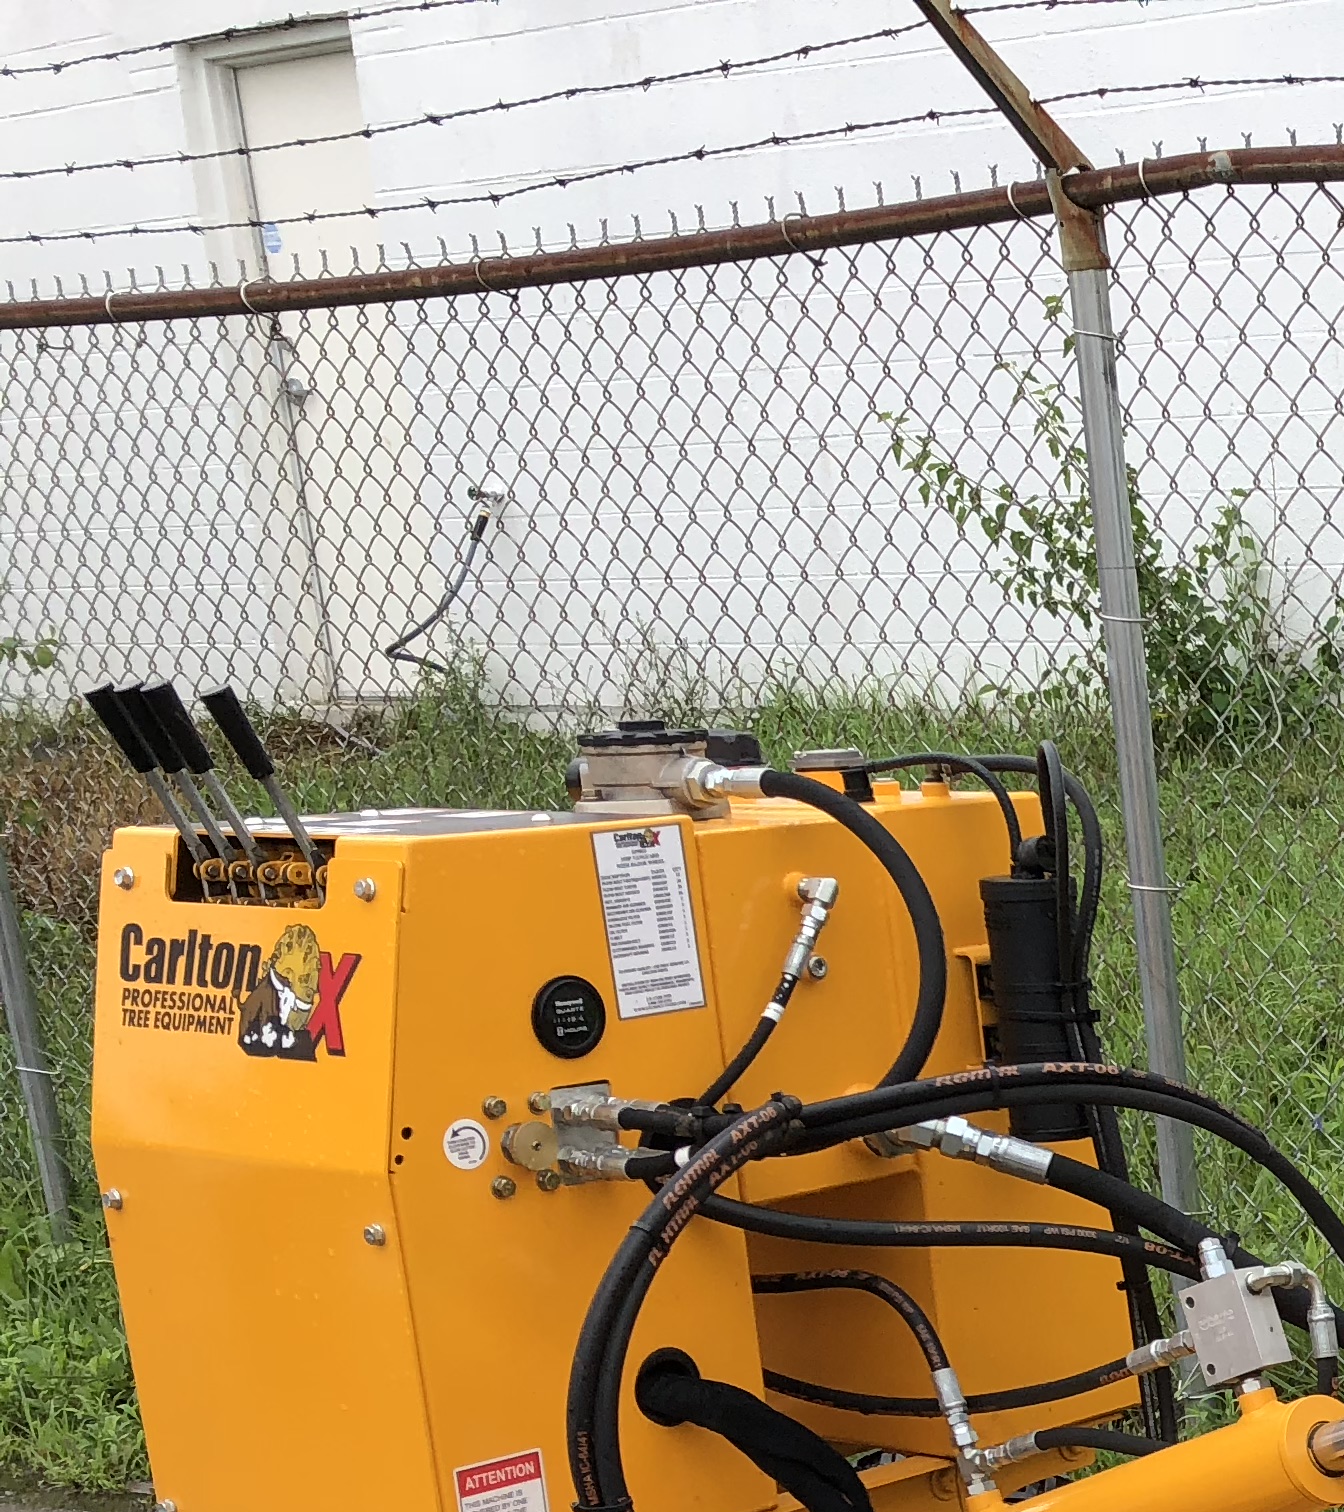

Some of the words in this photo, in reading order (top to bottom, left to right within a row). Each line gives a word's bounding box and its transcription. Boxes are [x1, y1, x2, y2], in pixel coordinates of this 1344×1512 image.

[120, 923, 262, 992] Carlton
[122, 988, 235, 1015] PROFESSIONAL
[121, 1008, 150, 1028] TREE
[153, 1011, 234, 1035] EQUIPMENT
[1041, 1062, 1120, 1075] AXT-06
[730, 1106, 777, 1144] AXT-06
[465, 1461, 535, 1490] ATTENTION
[482, 1491, 514, 1506] MACHINE
[502, 1501, 510, 1510] BY
[513, 1497, 528, 1507] ONE
